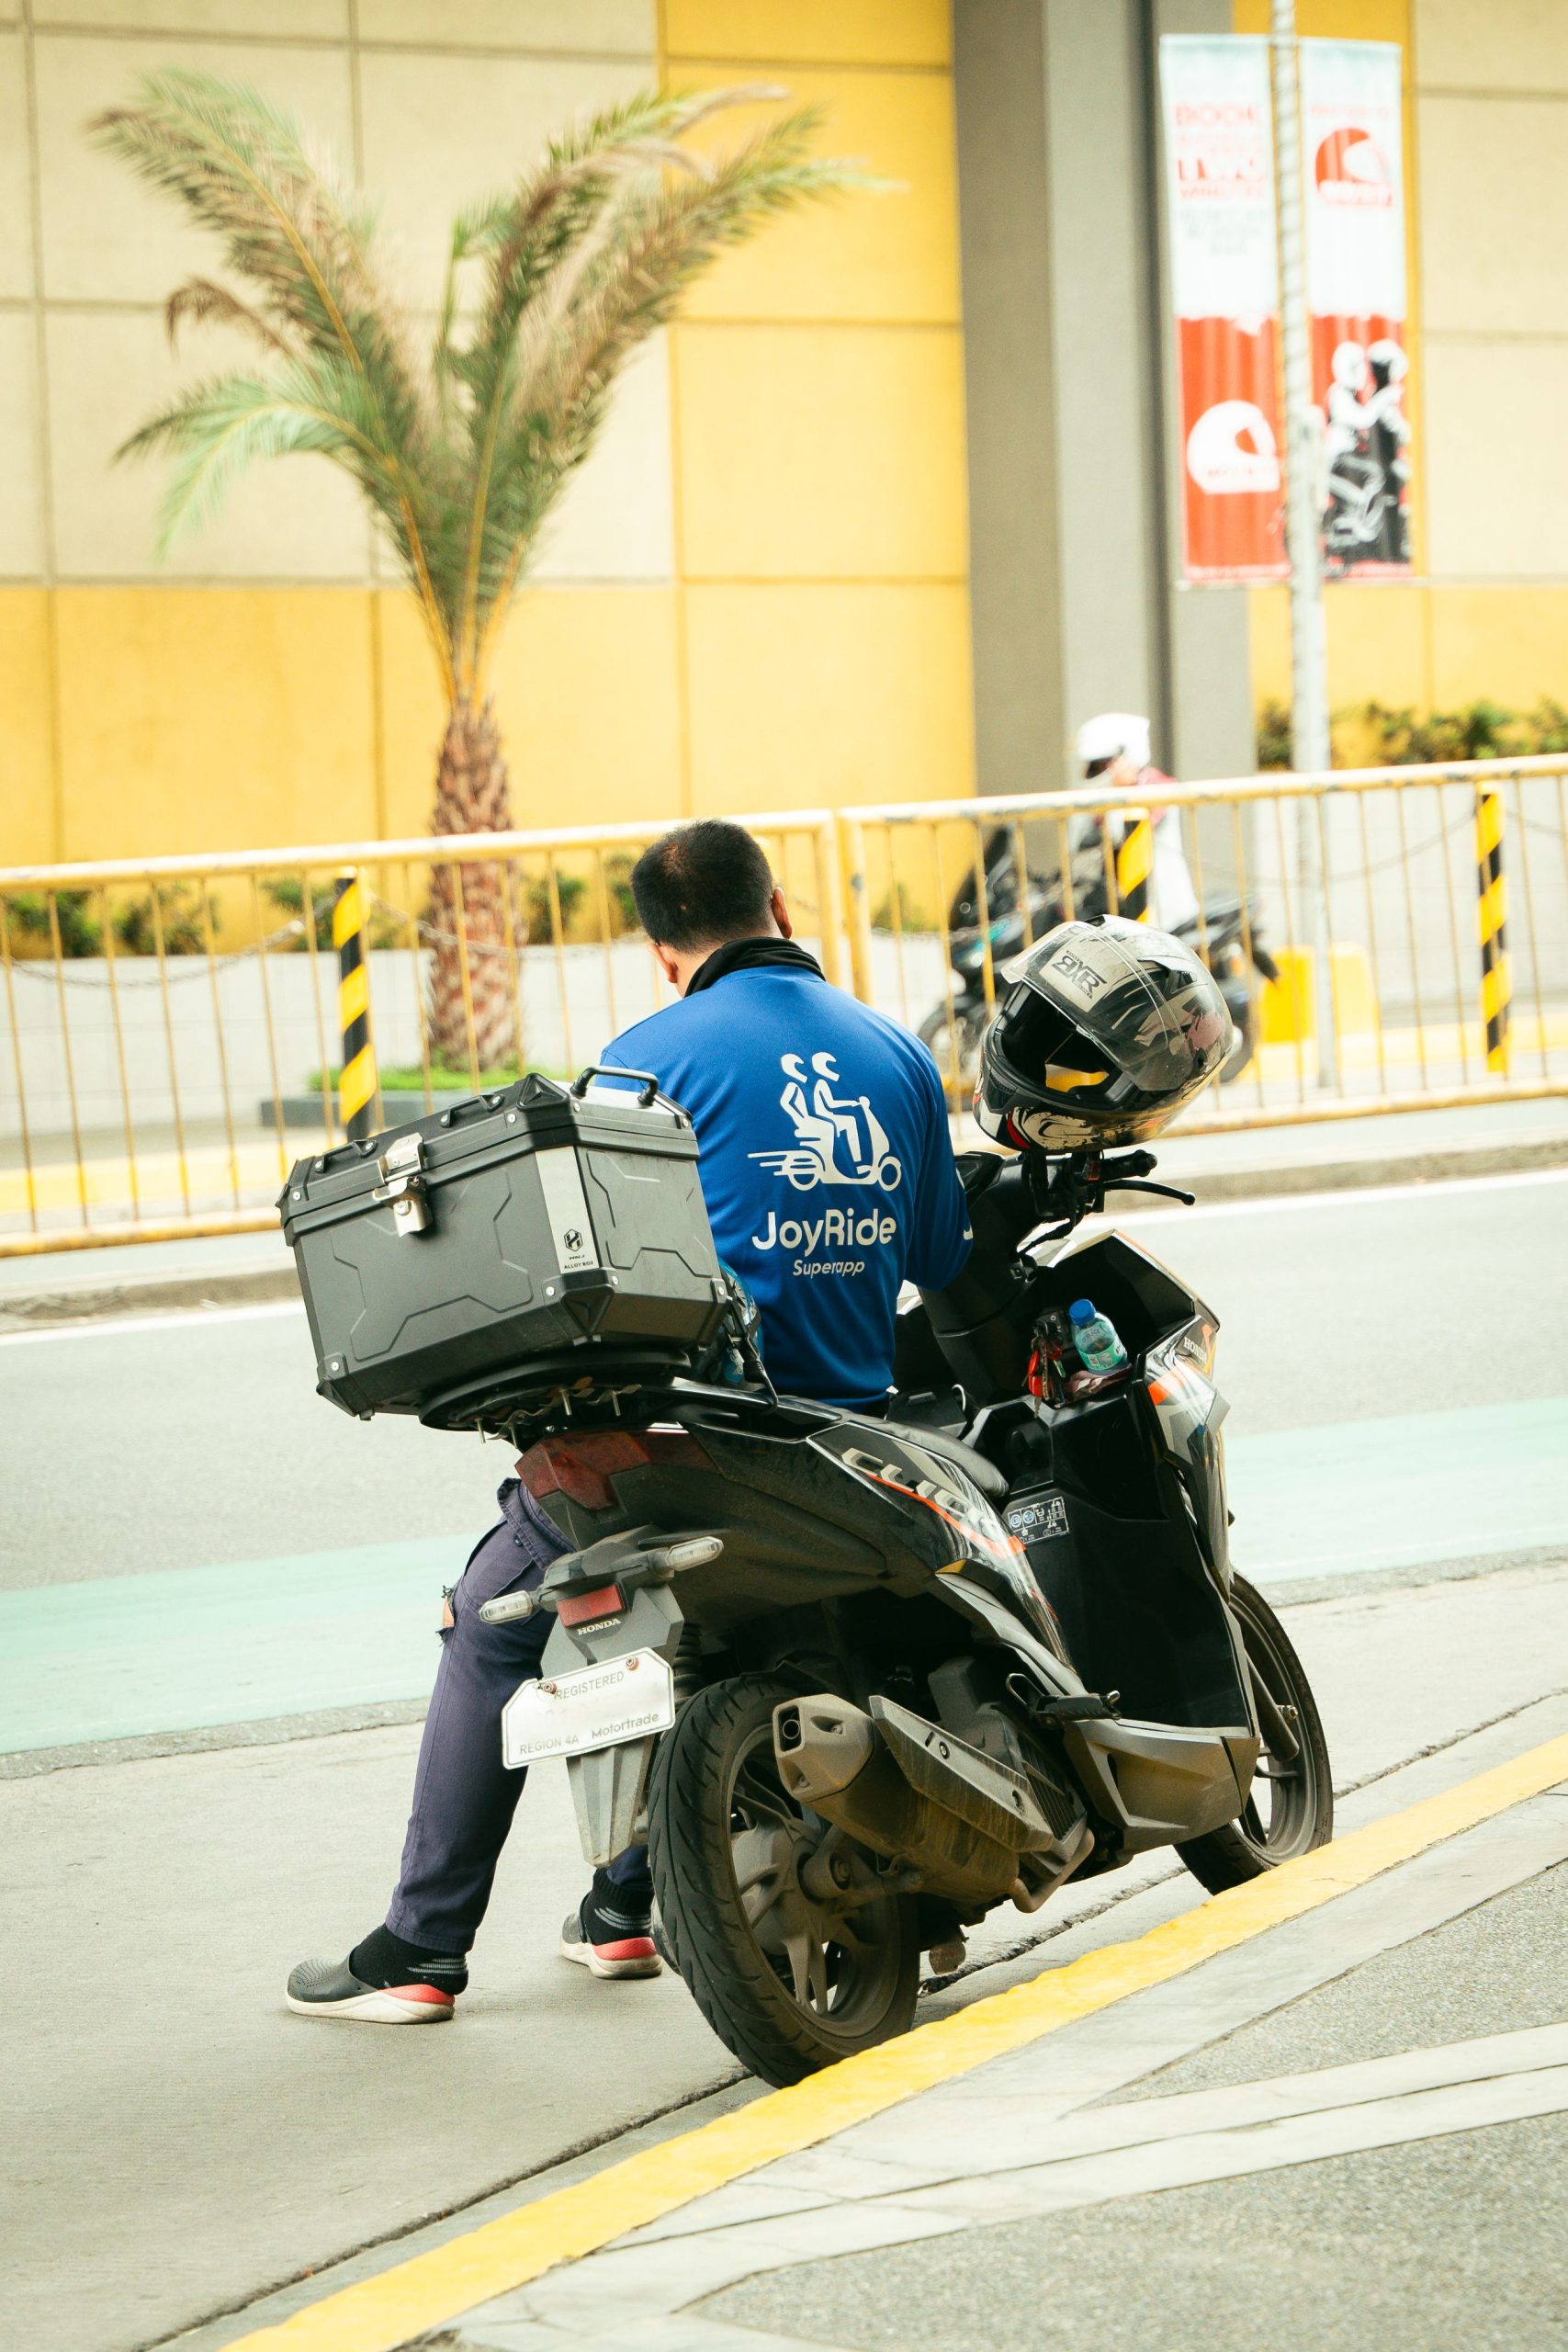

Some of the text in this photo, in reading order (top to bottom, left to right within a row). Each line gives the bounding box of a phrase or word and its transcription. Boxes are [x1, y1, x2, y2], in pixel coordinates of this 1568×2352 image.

[751, 1207, 897, 1257] JoyRide
[793, 1259, 865, 1279] Superapp
[577, 1618, 622, 1635] HONDA
[554, 1670, 625, 1701] REGISTERED
[592, 1713, 660, 1740] Motortrade
[520, 1735, 579, 1756] REGION 4A
